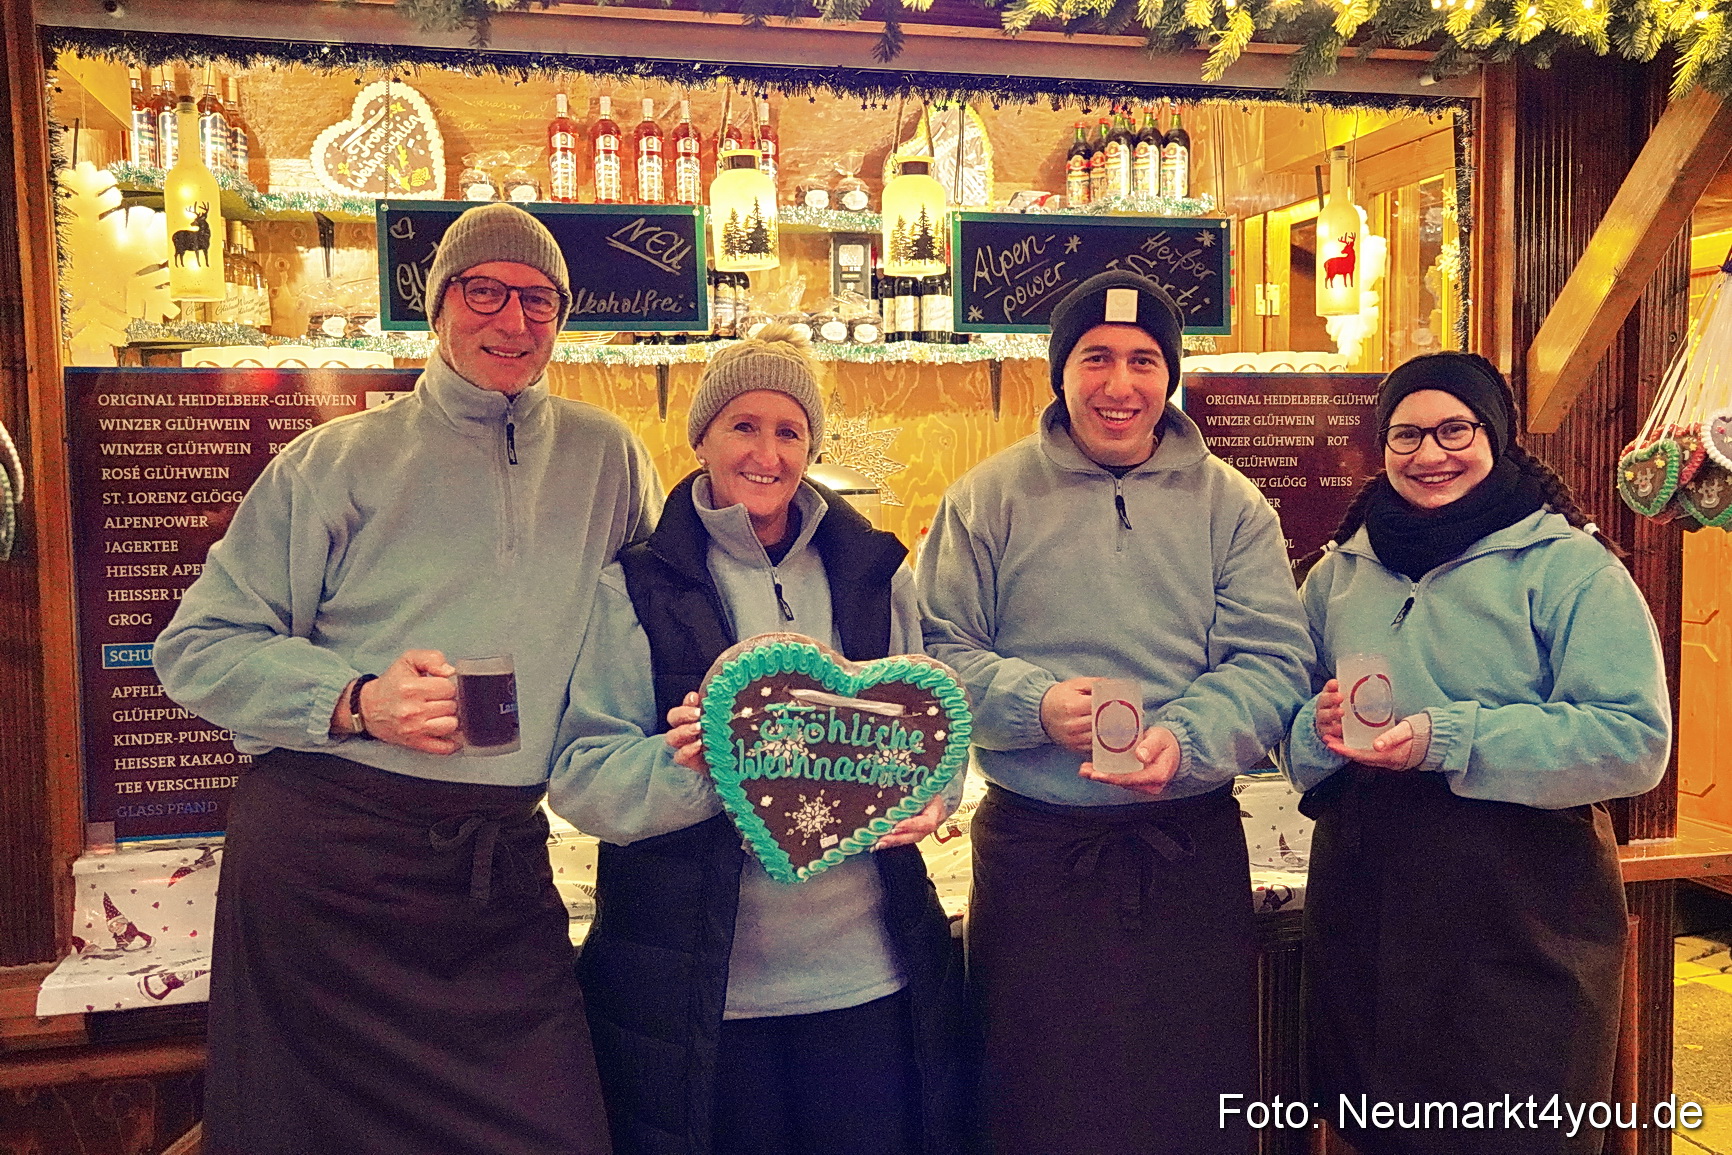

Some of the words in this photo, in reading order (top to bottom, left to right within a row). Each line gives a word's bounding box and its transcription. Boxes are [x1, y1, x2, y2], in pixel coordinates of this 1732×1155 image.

[1140, 230, 1217, 281] Heißer
[973, 234, 1056, 293] Alpen-
[1002, 261, 1066, 324] power
[98, 394, 175, 407] ORIGINAL
[179, 390, 357, 407] HEIDELBEER-GLÜHWEIN
[1206, 394, 1261, 405] ORIGINAL
[100, 418, 162, 431] WINZER
[165, 416, 251, 431] GLÜHWEIN
[268, 418, 313, 431] WEISS
[1206, 415, 1250, 426] WINZER
[1253, 413, 1315, 426] GLÜHWEIN
[1327, 415, 1361, 426] WEISS
[1206, 436, 1250, 447] WINZER
[1253, 434, 1315, 447] GLÜHWEIN
[1327, 436, 1349, 446] ROT
[100, 443, 163, 456] WINZER
[166, 440, 252, 455] GLÜHWEIN
[1236, 455, 1299, 467] GLÜHWEIN
[101, 465, 141, 480] ROSÉ
[144, 464, 230, 480] GLÜHWEIN
[1269, 475, 1307, 487] GLÖGG
[1320, 477, 1353, 487] WEISS
[103, 492, 125, 505] ST.
[128, 491, 188, 504] LORENZ
[191, 488, 243, 503] GLÖGG
[103, 516, 209, 529] ALPENPOWER
[105, 540, 179, 553] JAGERTEE
[106, 564, 169, 577] HEISSER
[107, 588, 170, 602] HEISSER
[108, 613, 152, 626] GROG
[760, 703, 926, 754] Fröhliche
[114, 756, 176, 770] HEISSER
[179, 753, 235, 767] KAKAO
[115, 781, 142, 794] TEE
[117, 805, 163, 818] GLASS
[167, 801, 218, 816] PFAND
